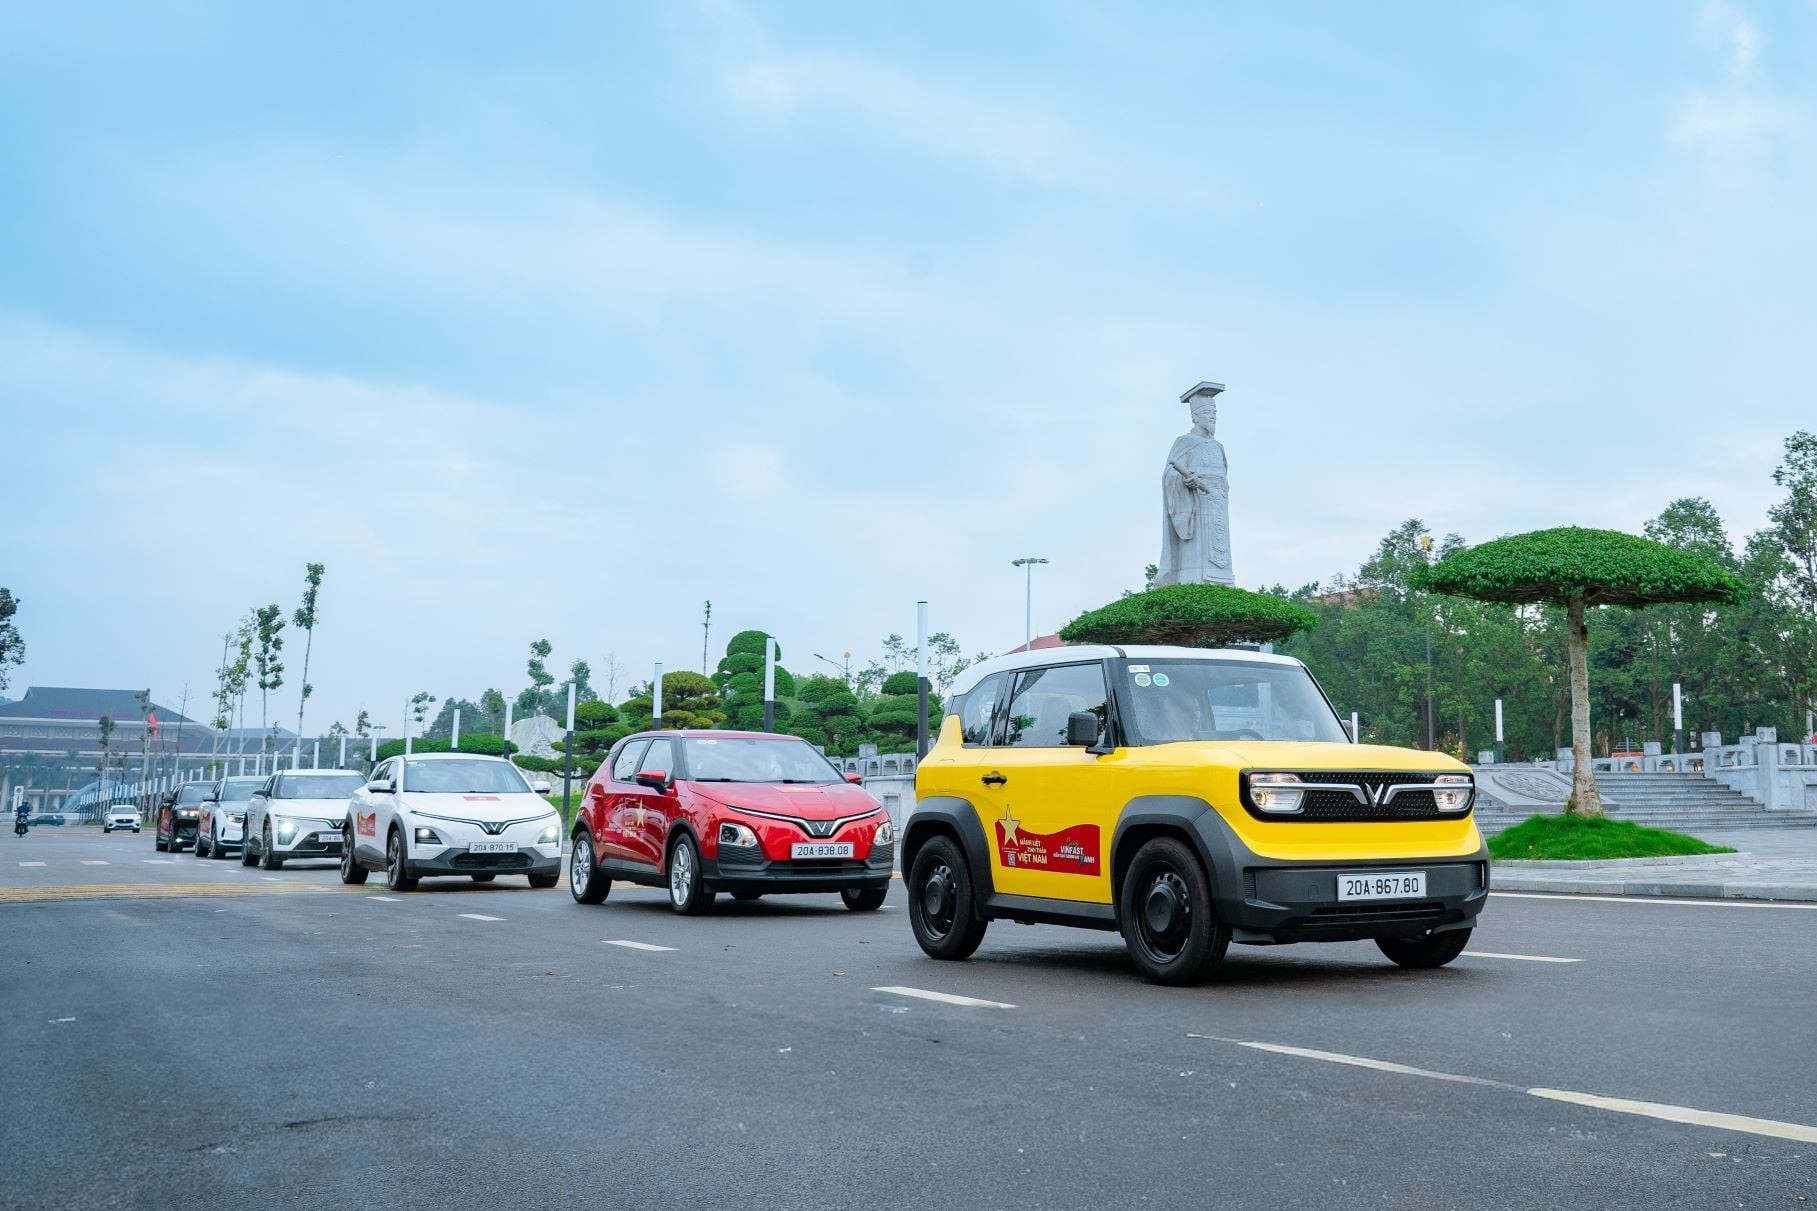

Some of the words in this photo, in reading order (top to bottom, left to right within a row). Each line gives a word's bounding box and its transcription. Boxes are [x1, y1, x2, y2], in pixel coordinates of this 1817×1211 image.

[1060, 845, 1084, 855] VINFAST
[1017, 851, 1032, 864] VIỆT
[1032, 854, 1048, 865] NAM
[1346, 878, 1419, 896] 20A-867.80
